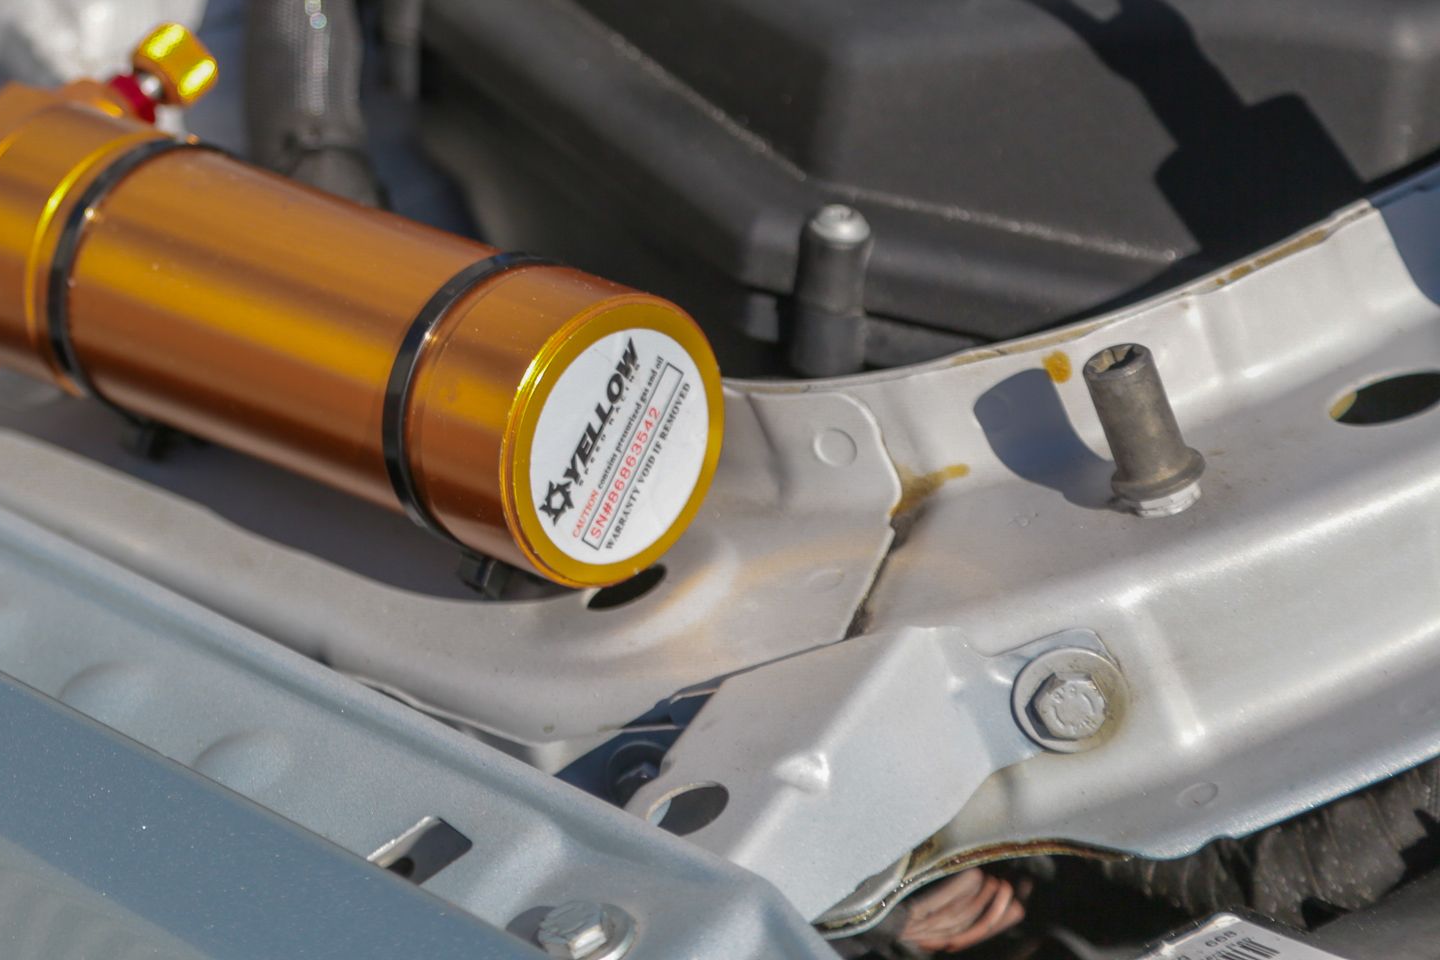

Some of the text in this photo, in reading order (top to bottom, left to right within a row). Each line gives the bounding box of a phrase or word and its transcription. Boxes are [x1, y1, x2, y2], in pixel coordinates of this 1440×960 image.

[563, 336, 638, 485] YELLOW
[572, 354, 665, 538] CAUTION contains pressurized gas and oil
[590, 406, 660, 539] SN#86863542
[605, 382, 691, 549] WARRANTY VOID IF REMOVED
